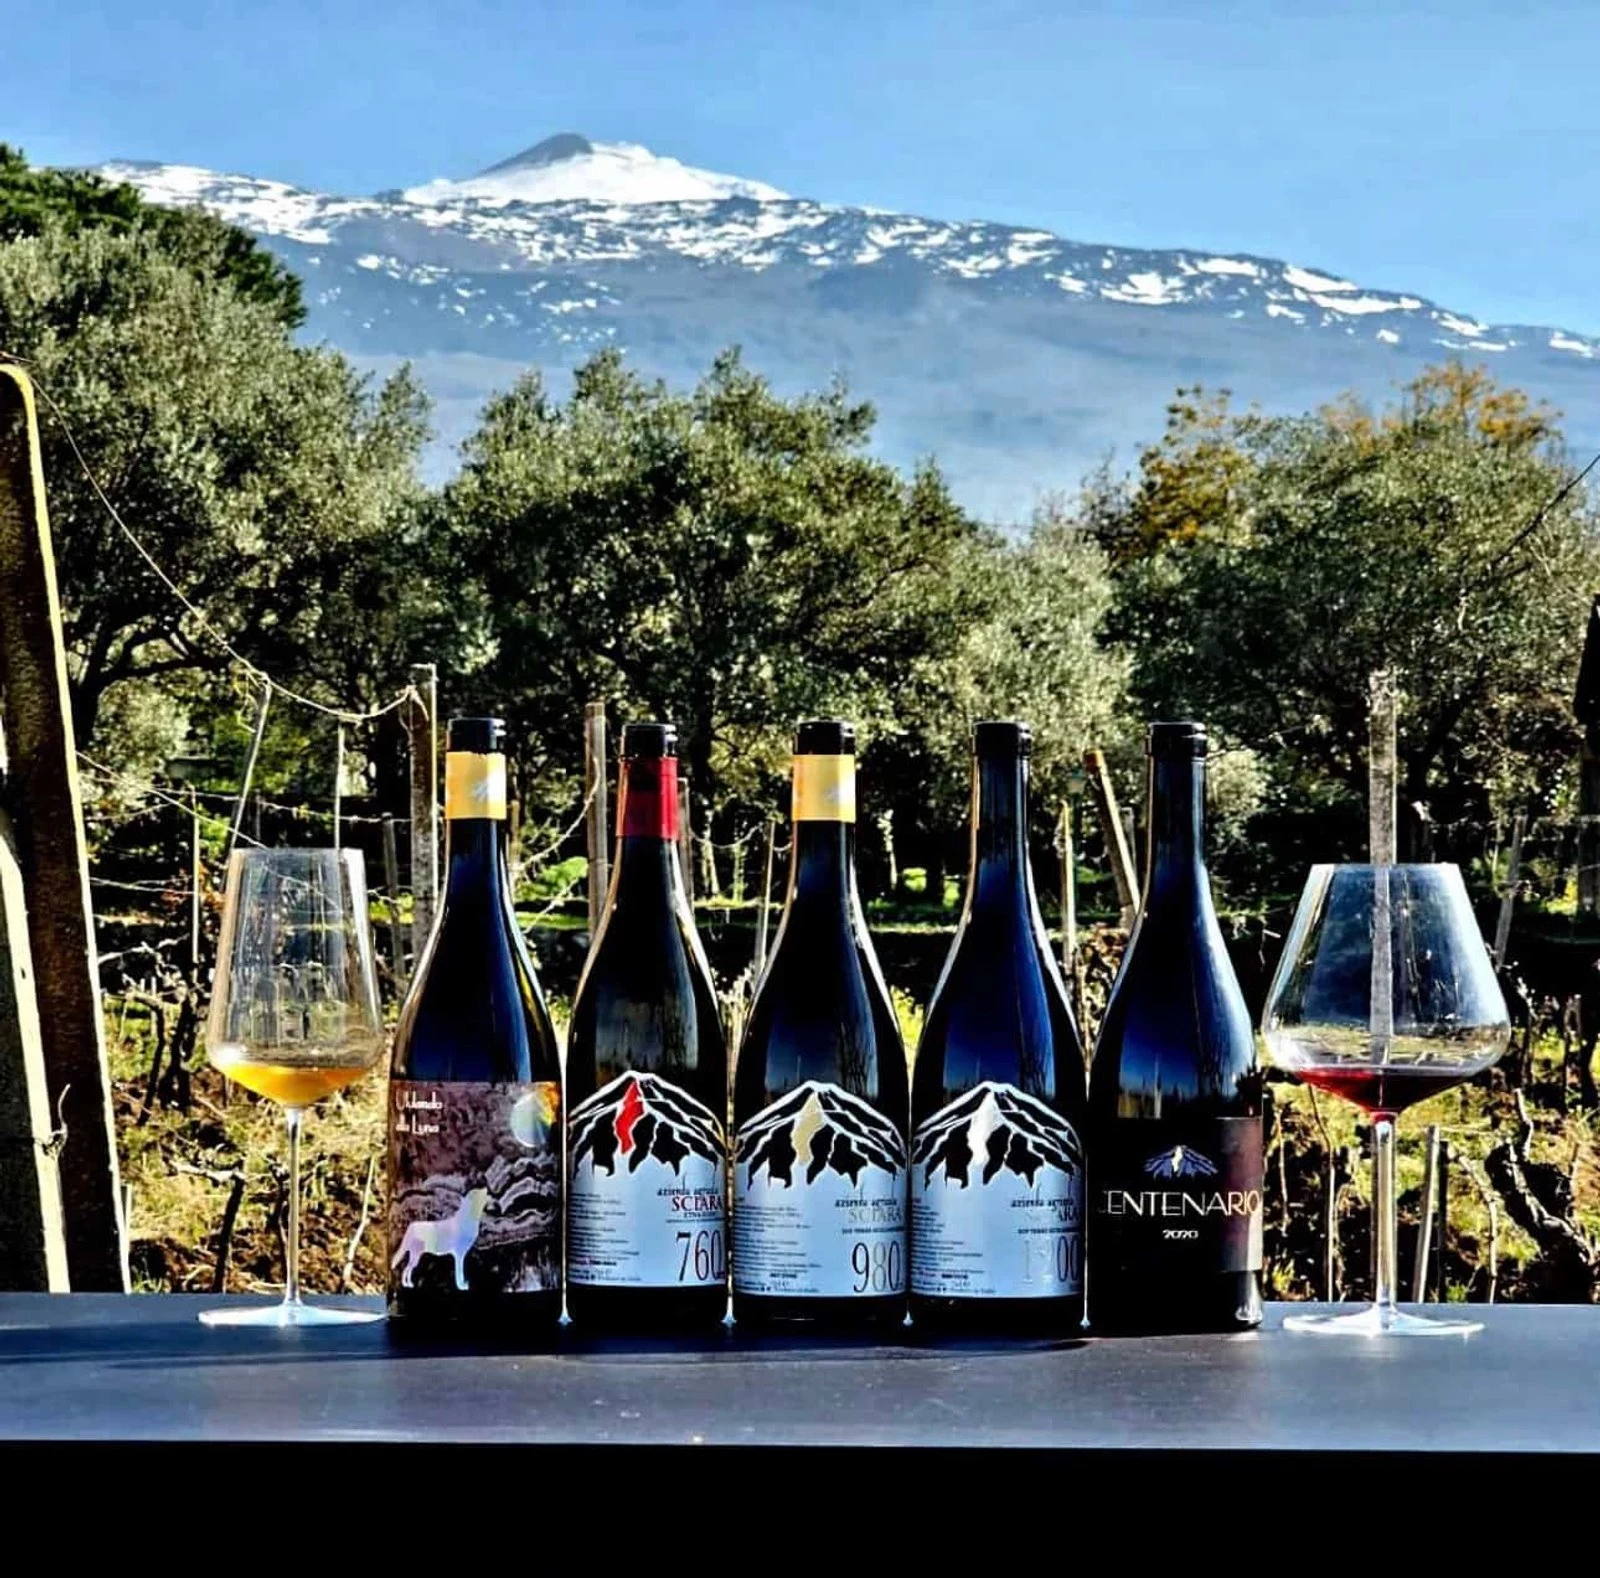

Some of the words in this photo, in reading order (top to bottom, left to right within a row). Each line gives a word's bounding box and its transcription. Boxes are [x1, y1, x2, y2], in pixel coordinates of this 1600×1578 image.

[672, 1195, 723, 1212] SCIARA
[1163, 1229, 1199, 1239] 2020
[676, 1230, 723, 1281] 760
[852, 1241, 901, 1293] 980
